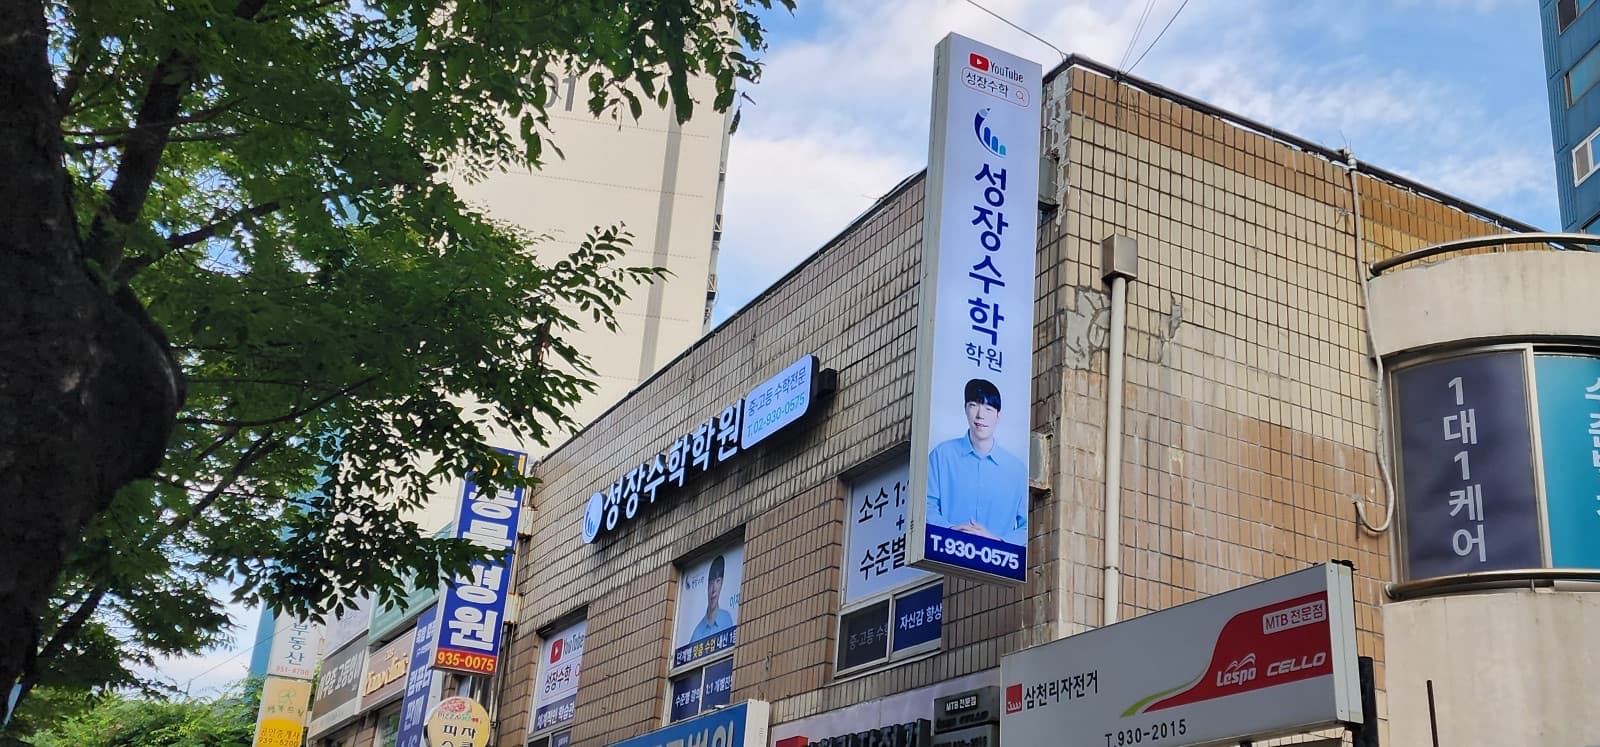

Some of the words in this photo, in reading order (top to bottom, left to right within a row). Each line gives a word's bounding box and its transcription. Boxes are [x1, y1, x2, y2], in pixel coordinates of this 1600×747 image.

[966, 71, 1008, 98] 성장수학
[990, 61, 1024, 83] YouTube
[968, 163, 1009, 346] 성장수학
[965, 342, 1002, 373] 학원
[603, 398, 742, 531] 성장수학학원
[858, 487, 889, 524] 소수
[893, 480, 909, 508] 1:
[930, 534, 1020, 570] T.930-0575
[900, 609, 925, 631] 자신감
[1265, 613, 1289, 631] MTB
[1290, 603, 1323, 625] 전문점
[437, 649, 495, 672] 935-0075
[1216, 666, 1257, 688] Lespo
[1266, 651, 1326, 678] CELLO
[1024, 669, 1098, 710] 삼천리자전거
[443, 724, 476, 739] 피자
[1104, 718, 1187, 747] T.930-2015
